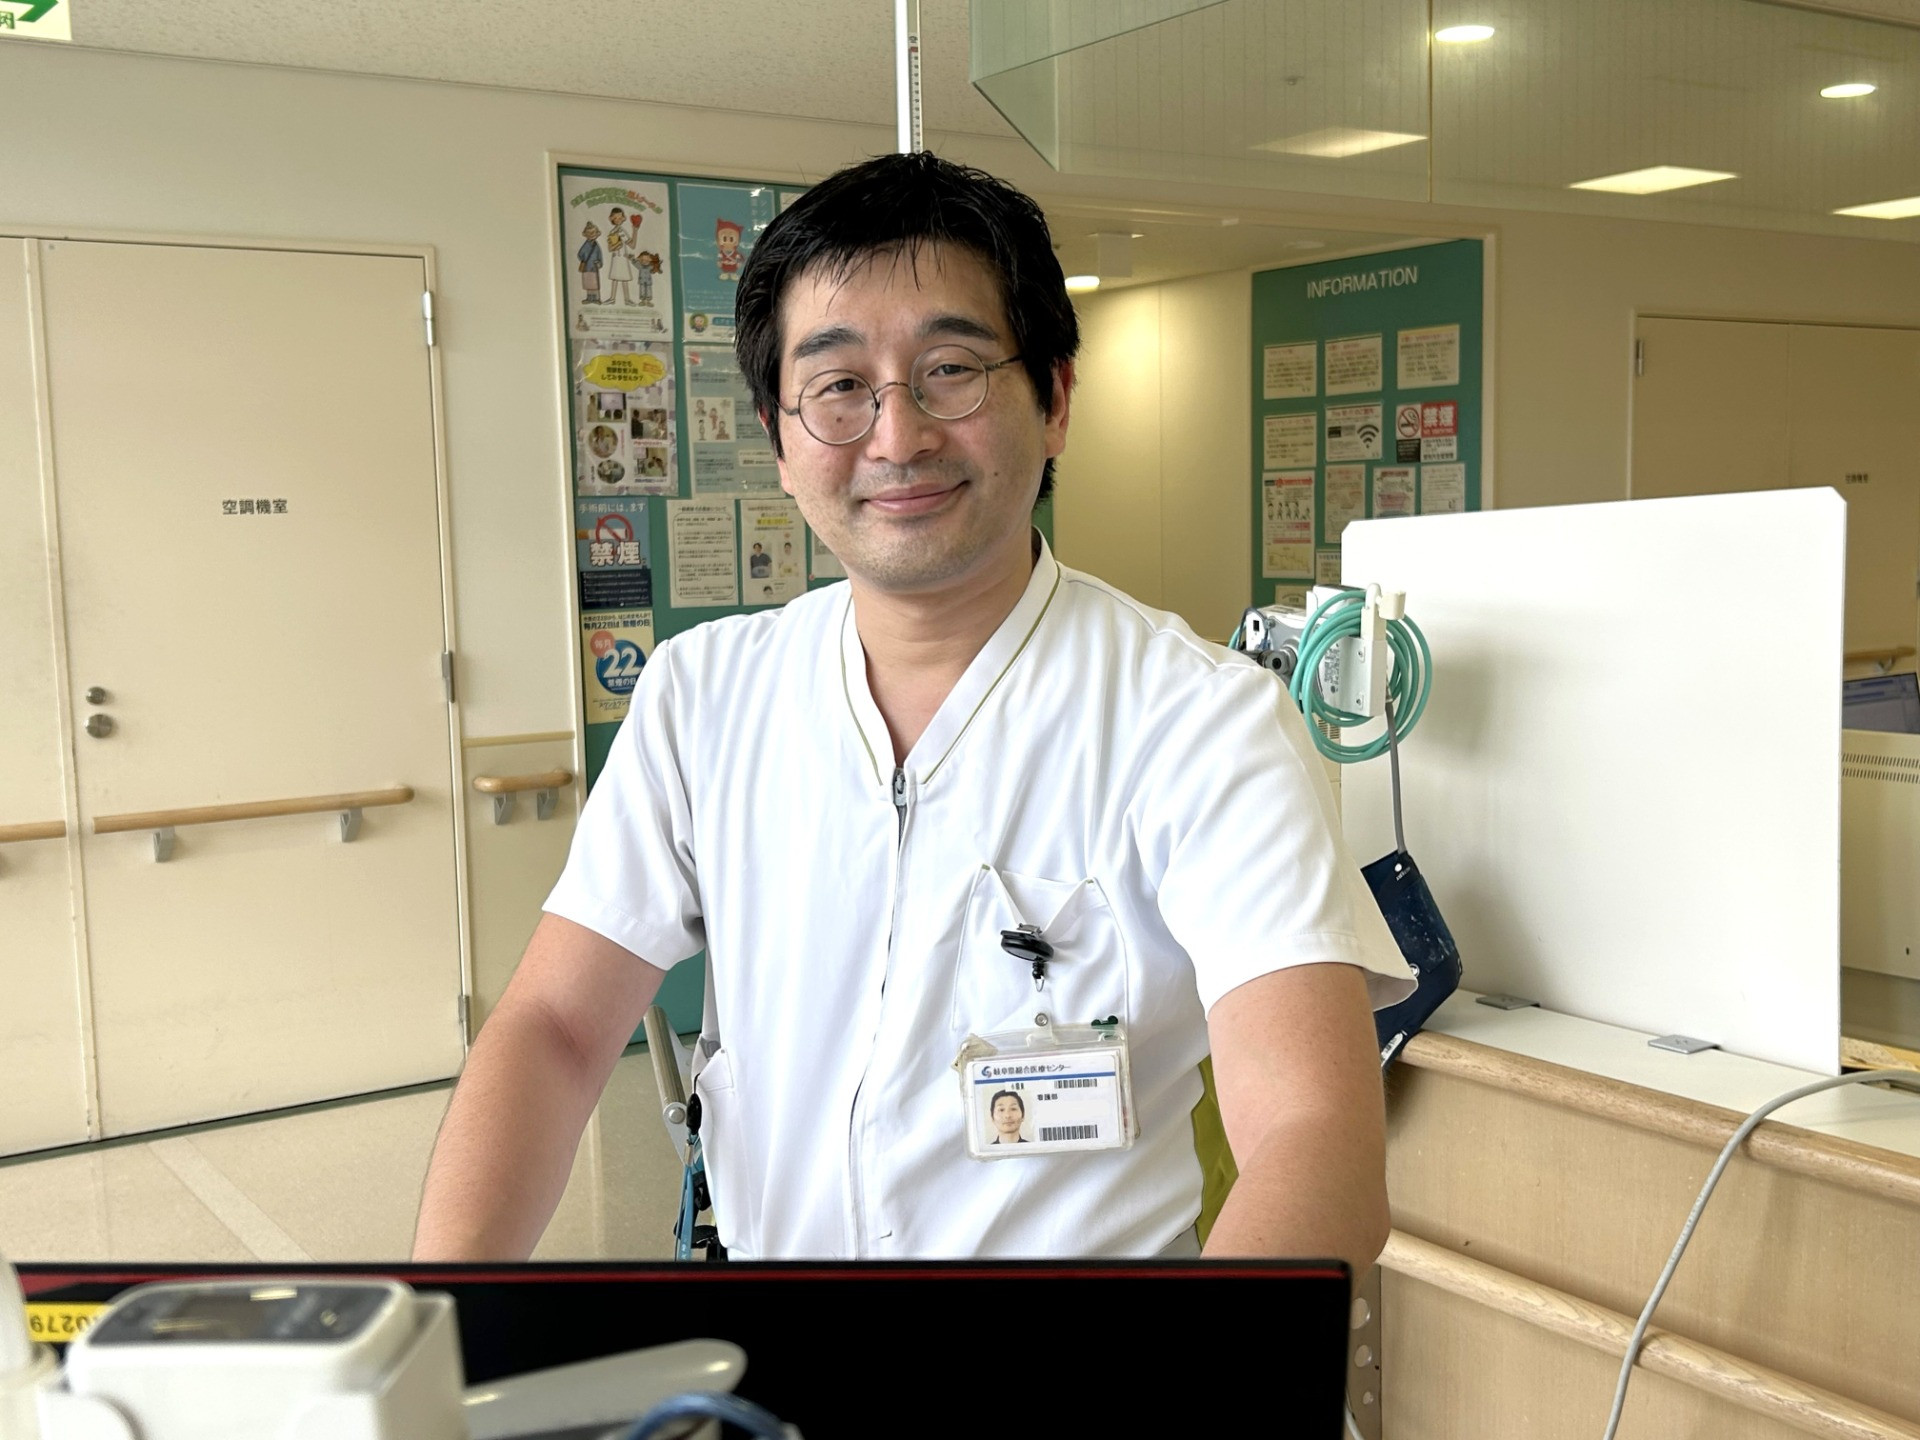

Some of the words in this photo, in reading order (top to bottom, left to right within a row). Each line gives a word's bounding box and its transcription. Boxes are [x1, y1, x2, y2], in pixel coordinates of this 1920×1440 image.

[1306, 265, 1418, 299] INFORMATION
[222, 498, 288, 515] 空調機室
[589, 540, 641, 567] 禁煙
[594, 639, 611, 650] 毎月
[602, 646, 644, 678] 22
[29, 1313, 98, 1334] 0279
